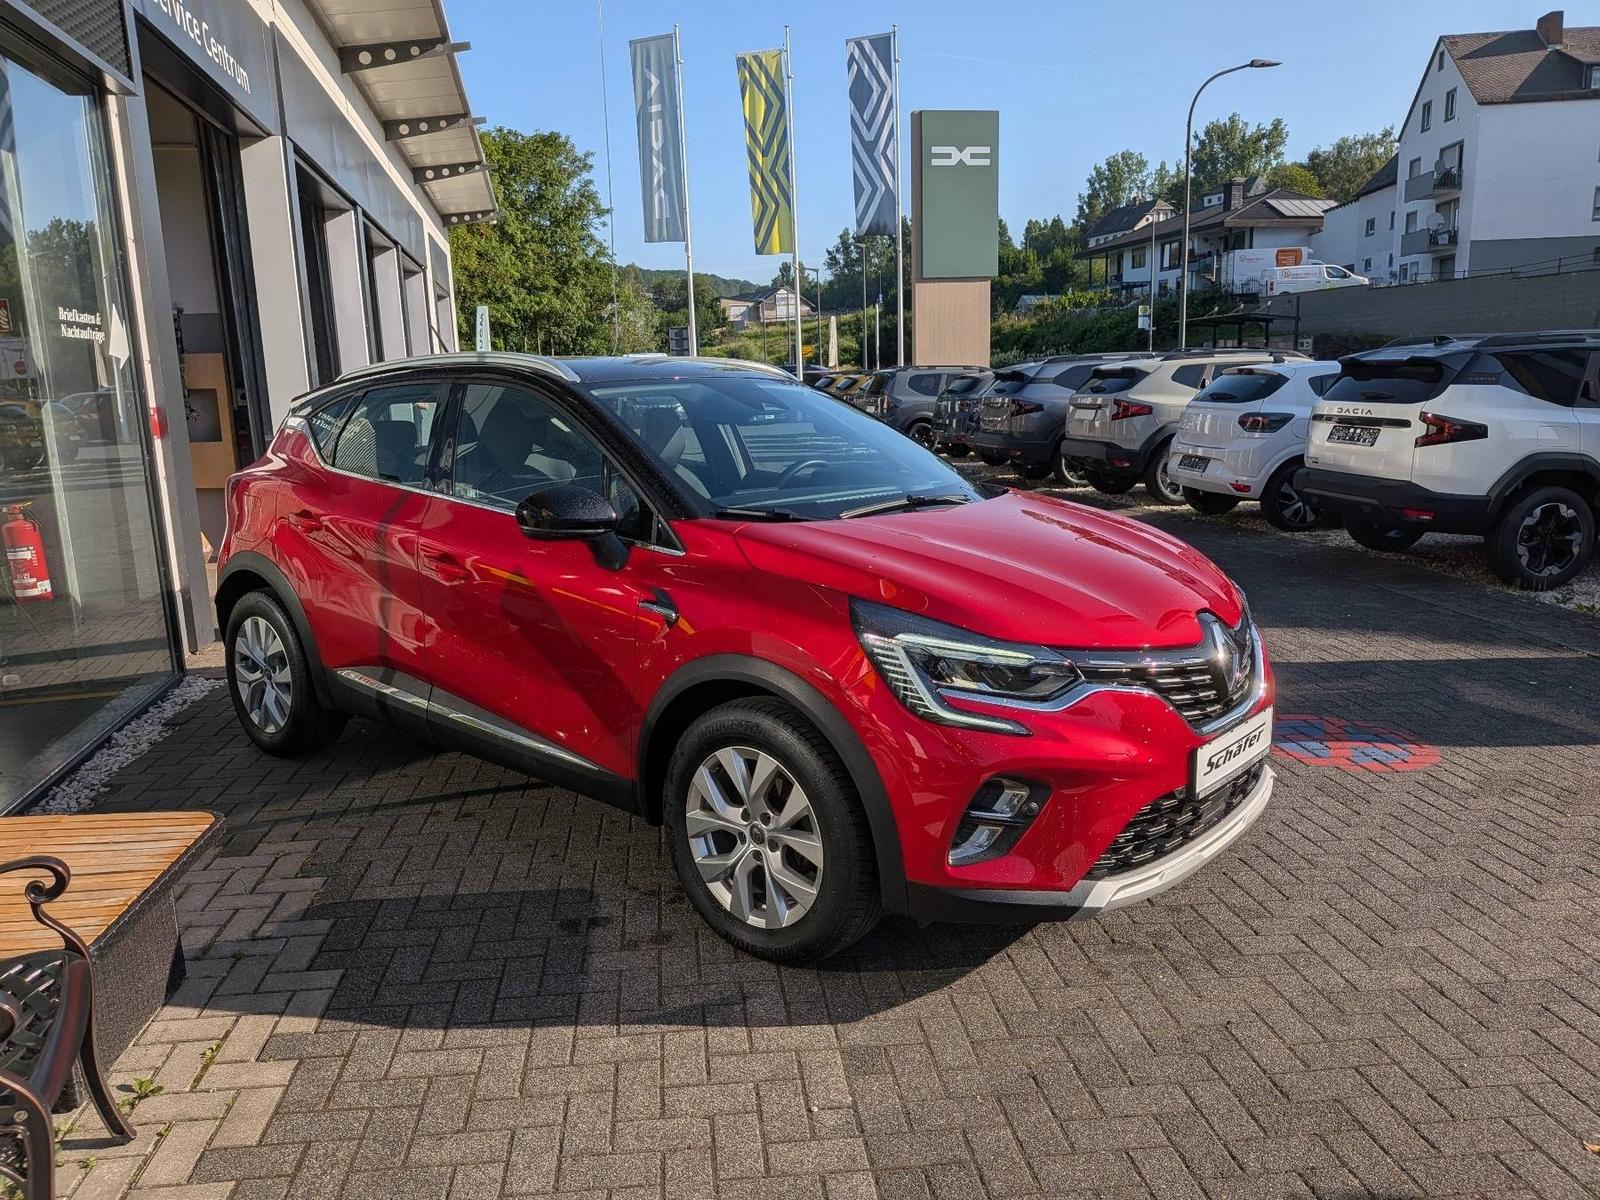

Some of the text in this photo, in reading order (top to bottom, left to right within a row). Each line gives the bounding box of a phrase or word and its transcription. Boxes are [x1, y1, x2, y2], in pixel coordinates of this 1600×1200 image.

[202, 21, 251, 94] Centrum
[58, 306, 102, 325] Briefkasten &
[61, 323, 106, 345] Nachtaufträge
[1336, 407, 1373, 416] DACIA
[1203, 721, 1267, 777] Schäfer
